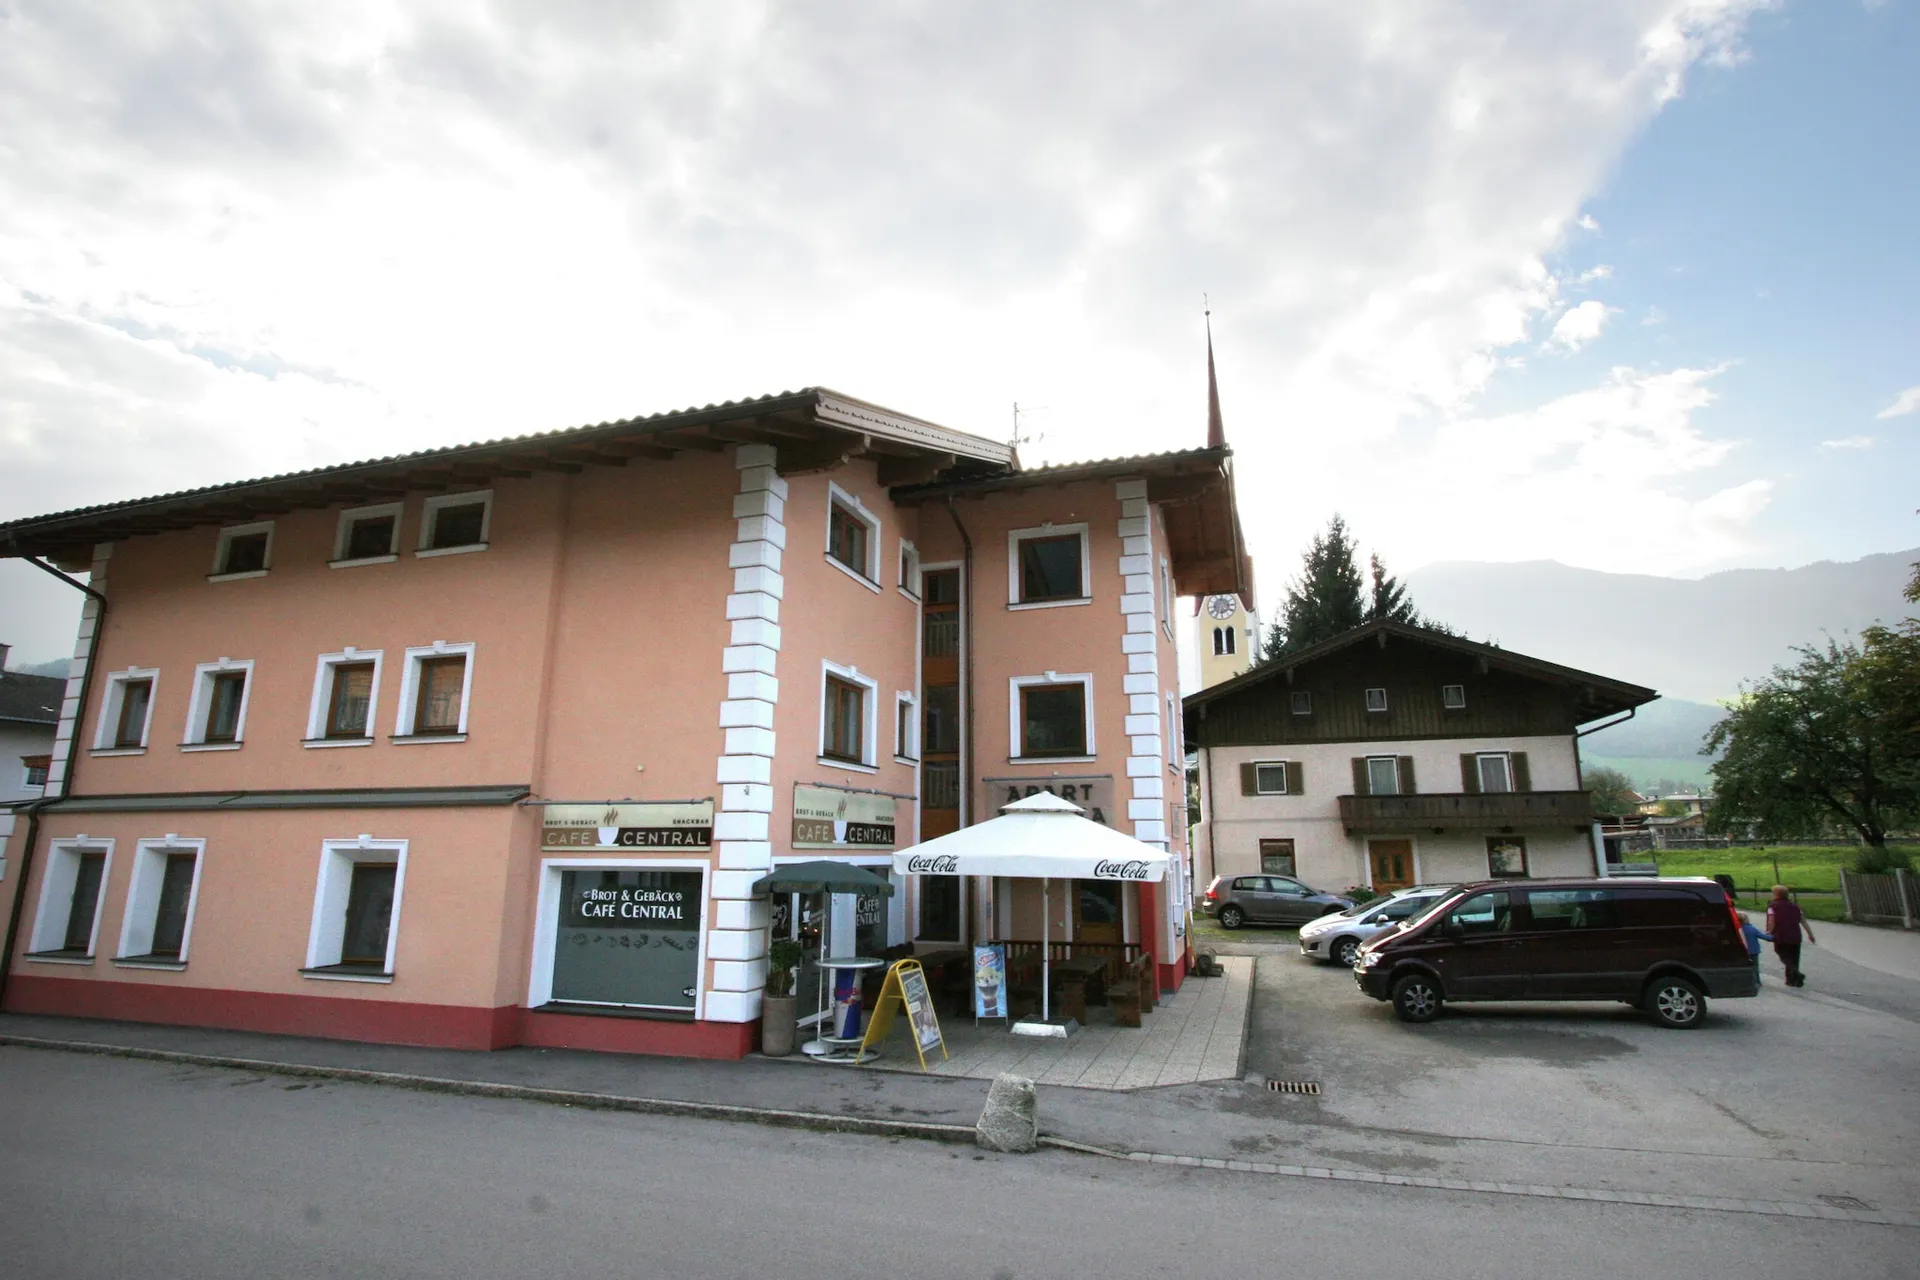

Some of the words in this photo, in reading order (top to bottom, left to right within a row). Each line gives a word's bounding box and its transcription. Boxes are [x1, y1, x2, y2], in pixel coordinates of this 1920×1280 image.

[547, 830, 591, 845] CAFÉ
[623, 831, 707, 845] CENTRAL
[797, 822, 829, 841] CAFÉ
[849, 826, 893, 843] CENTRAL
[621, 889, 630, 901] &
[581, 901, 616, 917] CAFÉ
[621, 901, 684, 919] CENTRAL
[856, 911, 880, 927] ENTRAL
